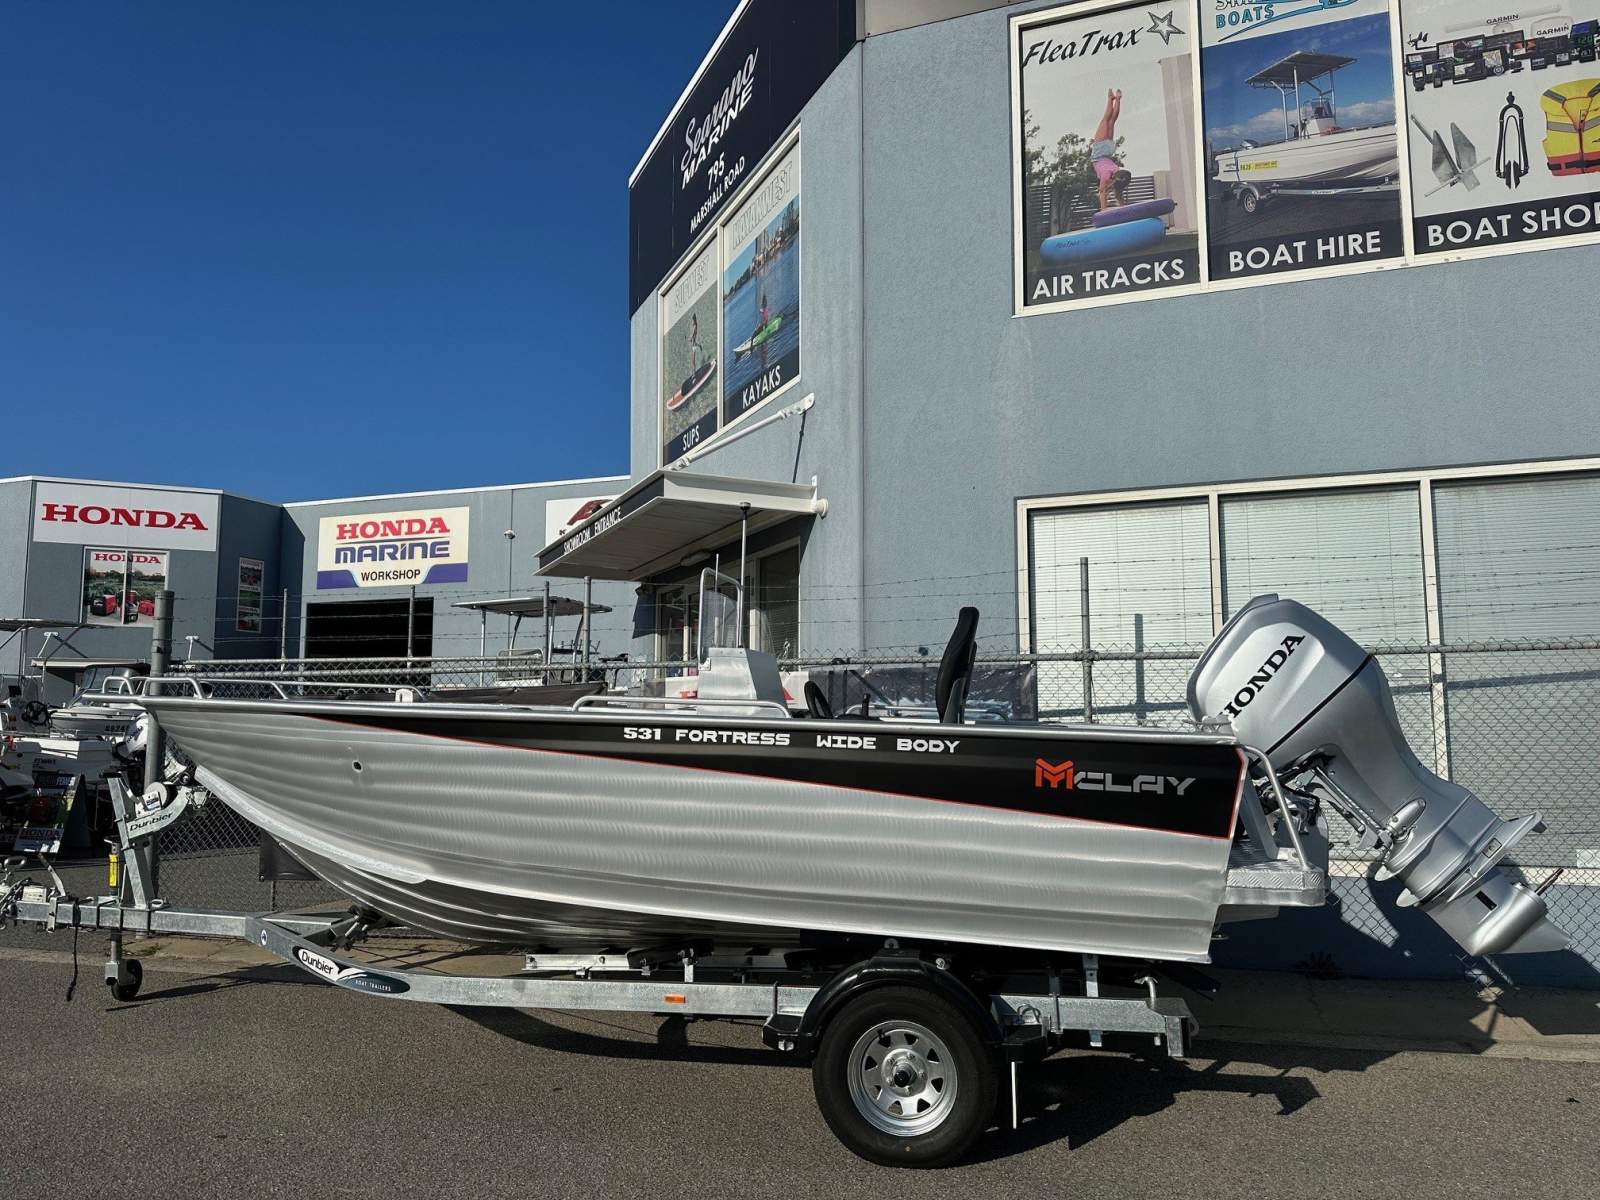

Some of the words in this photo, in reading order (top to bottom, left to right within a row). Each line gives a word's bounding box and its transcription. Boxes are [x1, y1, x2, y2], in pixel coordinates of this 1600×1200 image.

[1216, 4, 1274, 29] BOATS
[1486, 14, 1520, 25] GARMIN
[1536, 26, 1569, 36] GARMIN
[1022, 27, 1144, 69] FleaTrax
[682, 77, 754, 190] MARINE
[708, 152, 724, 190] 795
[690, 188, 723, 233] MARSHALL
[724, 156, 745, 191] ROAD
[1427, 214, 1511, 246] BOAT
[1229, 241, 1306, 272] BOAT
[1317, 231, 1381, 260] HIRE
[1032, 274, 1074, 300] AIR
[1082, 258, 1185, 292] TRACKS
[742, 365, 781, 409] KAYAKS
[682, 425, 700, 451] SUPS
[41, 503, 209, 531] HONDA
[336, 517, 451, 541] HONDA
[594, 506, 621, 536] ENTRANCE
[94, 553, 161, 564] HONDA
[334, 540, 450, 565] MARINE
[360, 569, 421, 582] WORKSHOP
[623, 727, 661, 740] 531
[675, 729, 790, 746] FORTRESS
[816, 735, 876, 750] WIDE
[897, 738, 961, 753] BODY
[129, 812, 173, 832] Dunbier
[301, 950, 334, 975] Dunbier
